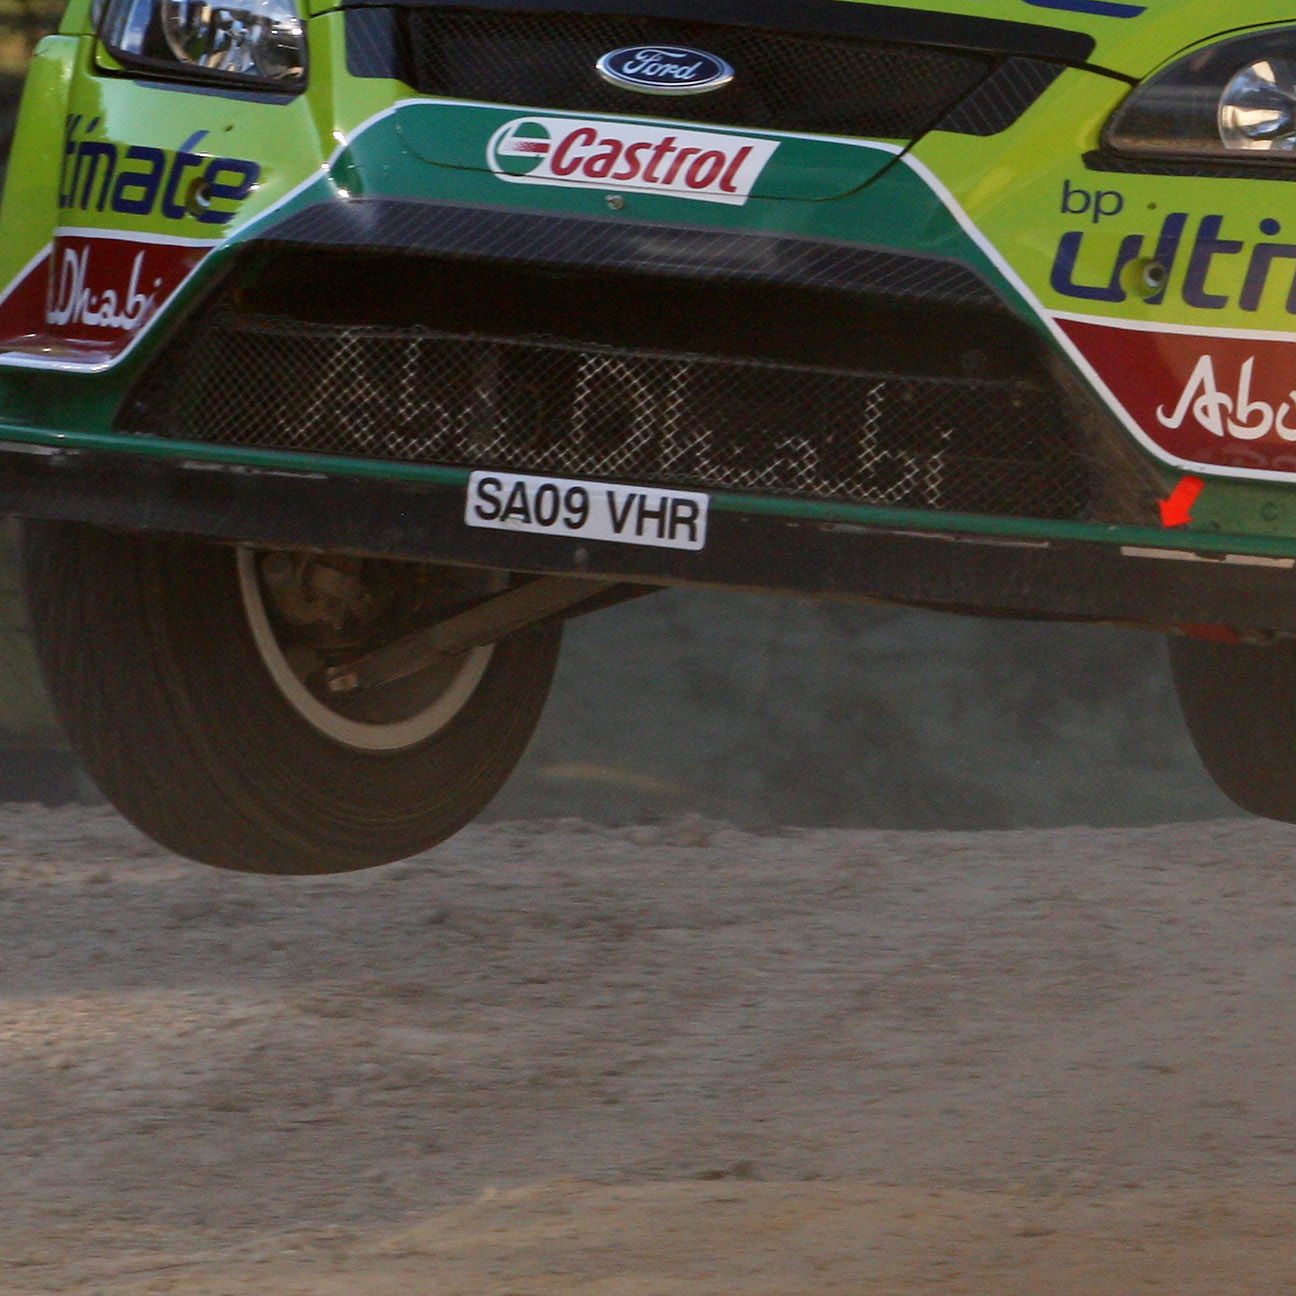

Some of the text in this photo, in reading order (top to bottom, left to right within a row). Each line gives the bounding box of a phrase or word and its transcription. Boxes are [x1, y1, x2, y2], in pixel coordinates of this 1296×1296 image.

[622, 49, 703, 81] Ford
[550, 127, 754, 193] Castrol
[1061, 180, 1124, 224] bp
[52, 245, 163, 329] Dhabi
[474, 476, 700, 544] SA09 VHR
